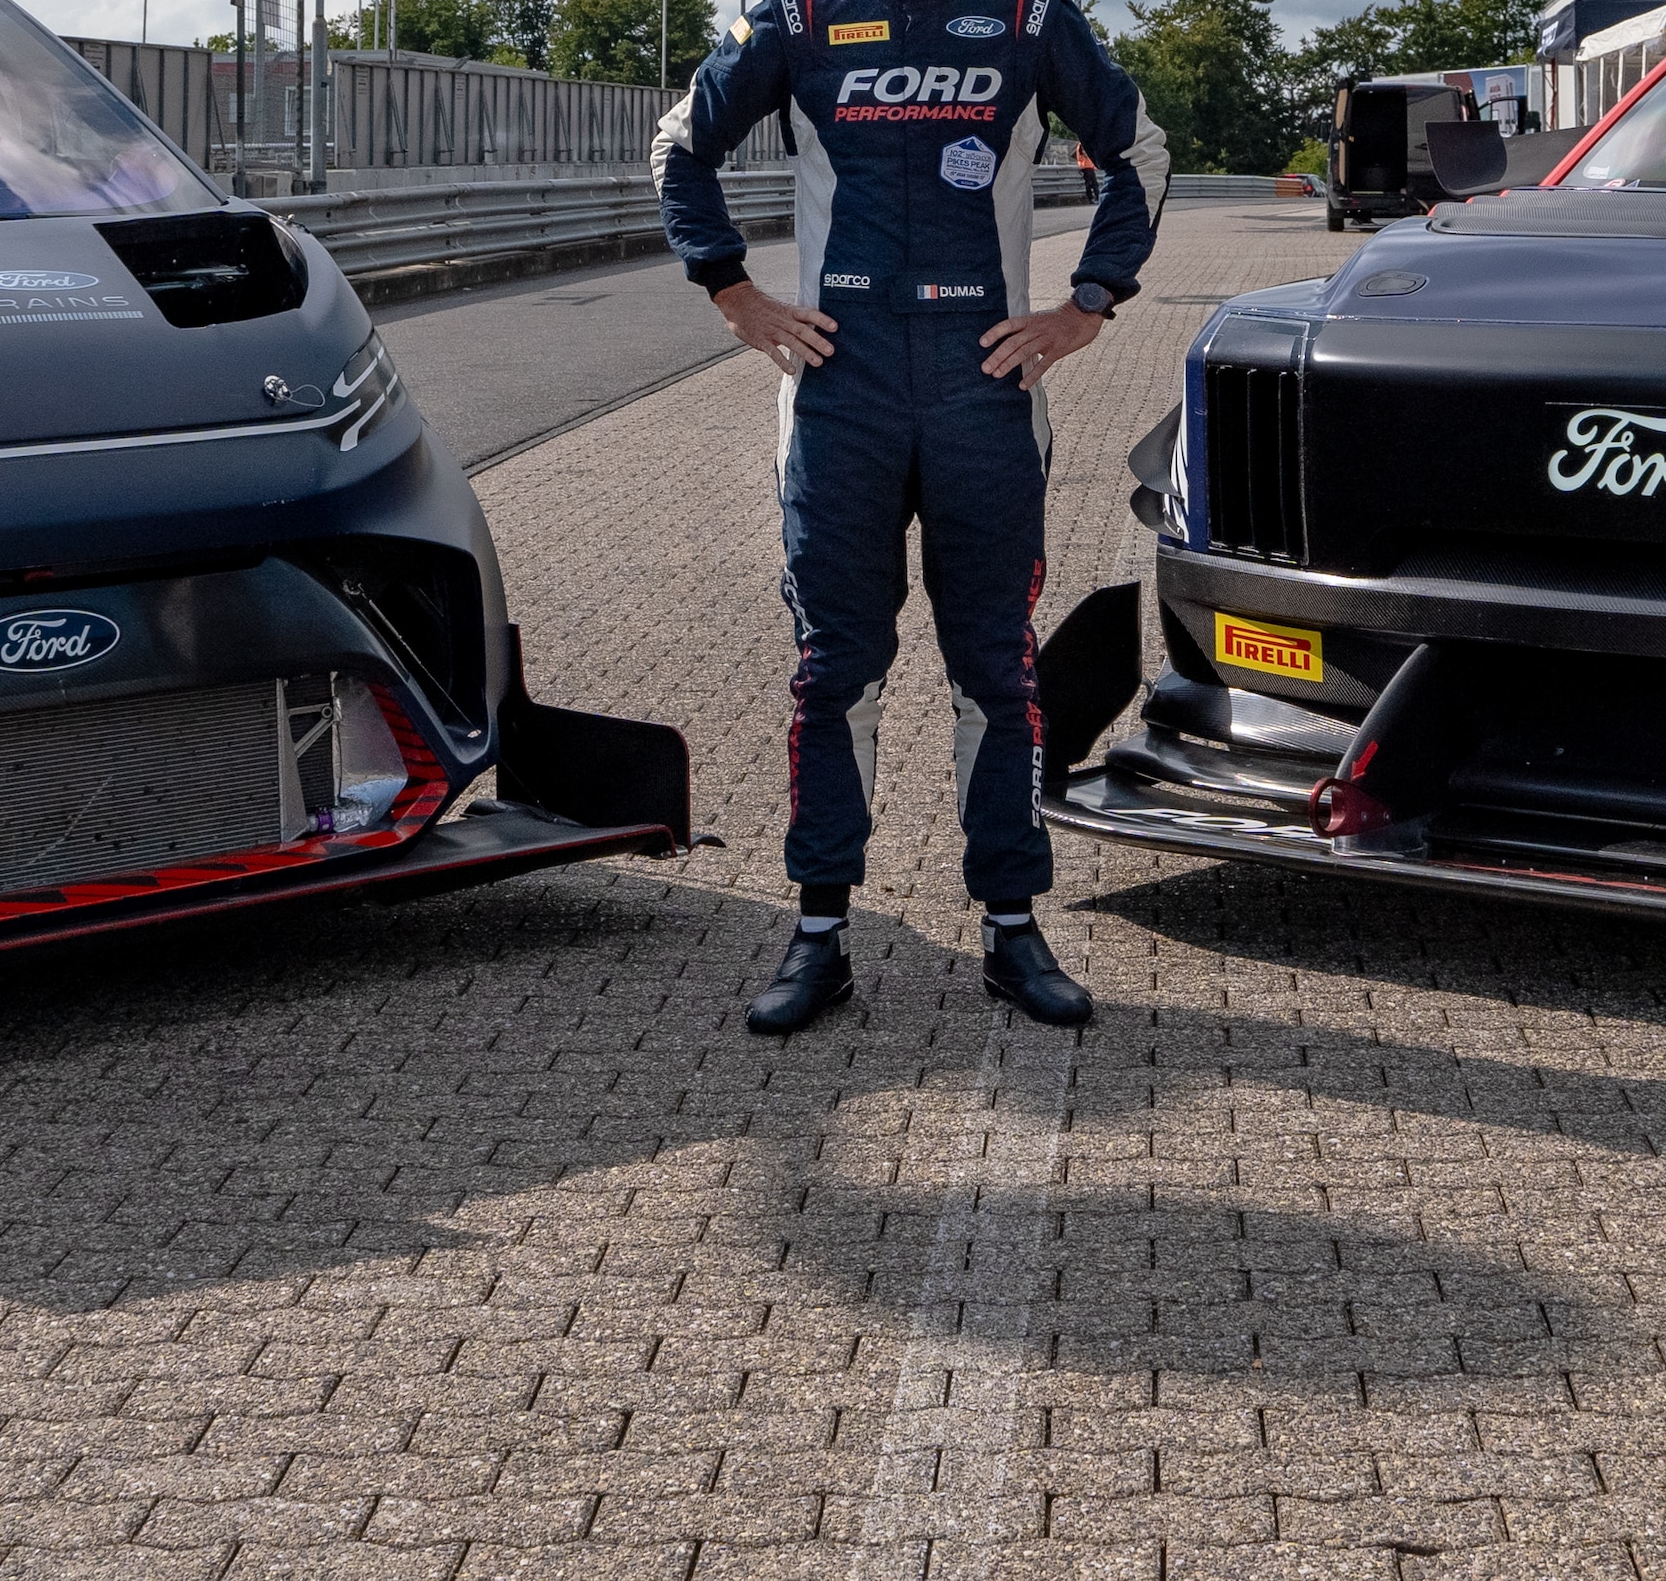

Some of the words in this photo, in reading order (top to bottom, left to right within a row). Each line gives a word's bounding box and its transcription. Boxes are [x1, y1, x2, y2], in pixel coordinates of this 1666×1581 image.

[834, 25, 883, 40] PIRELLI
[958, 19, 994, 35] Ford
[837, 66, 1002, 104] FORD
[835, 105, 997, 122] PERFORMANCE
[947, 158, 969, 166] PIKES
[971, 161, 990, 169] PEAK
[822, 273, 870, 289] sparco
[940, 286, 984, 297] DUMAS
[1, 618, 91, 664] Ford
[1225, 624, 1311, 670] PIRELLI
[1032, 746, 1043, 828] FORD
